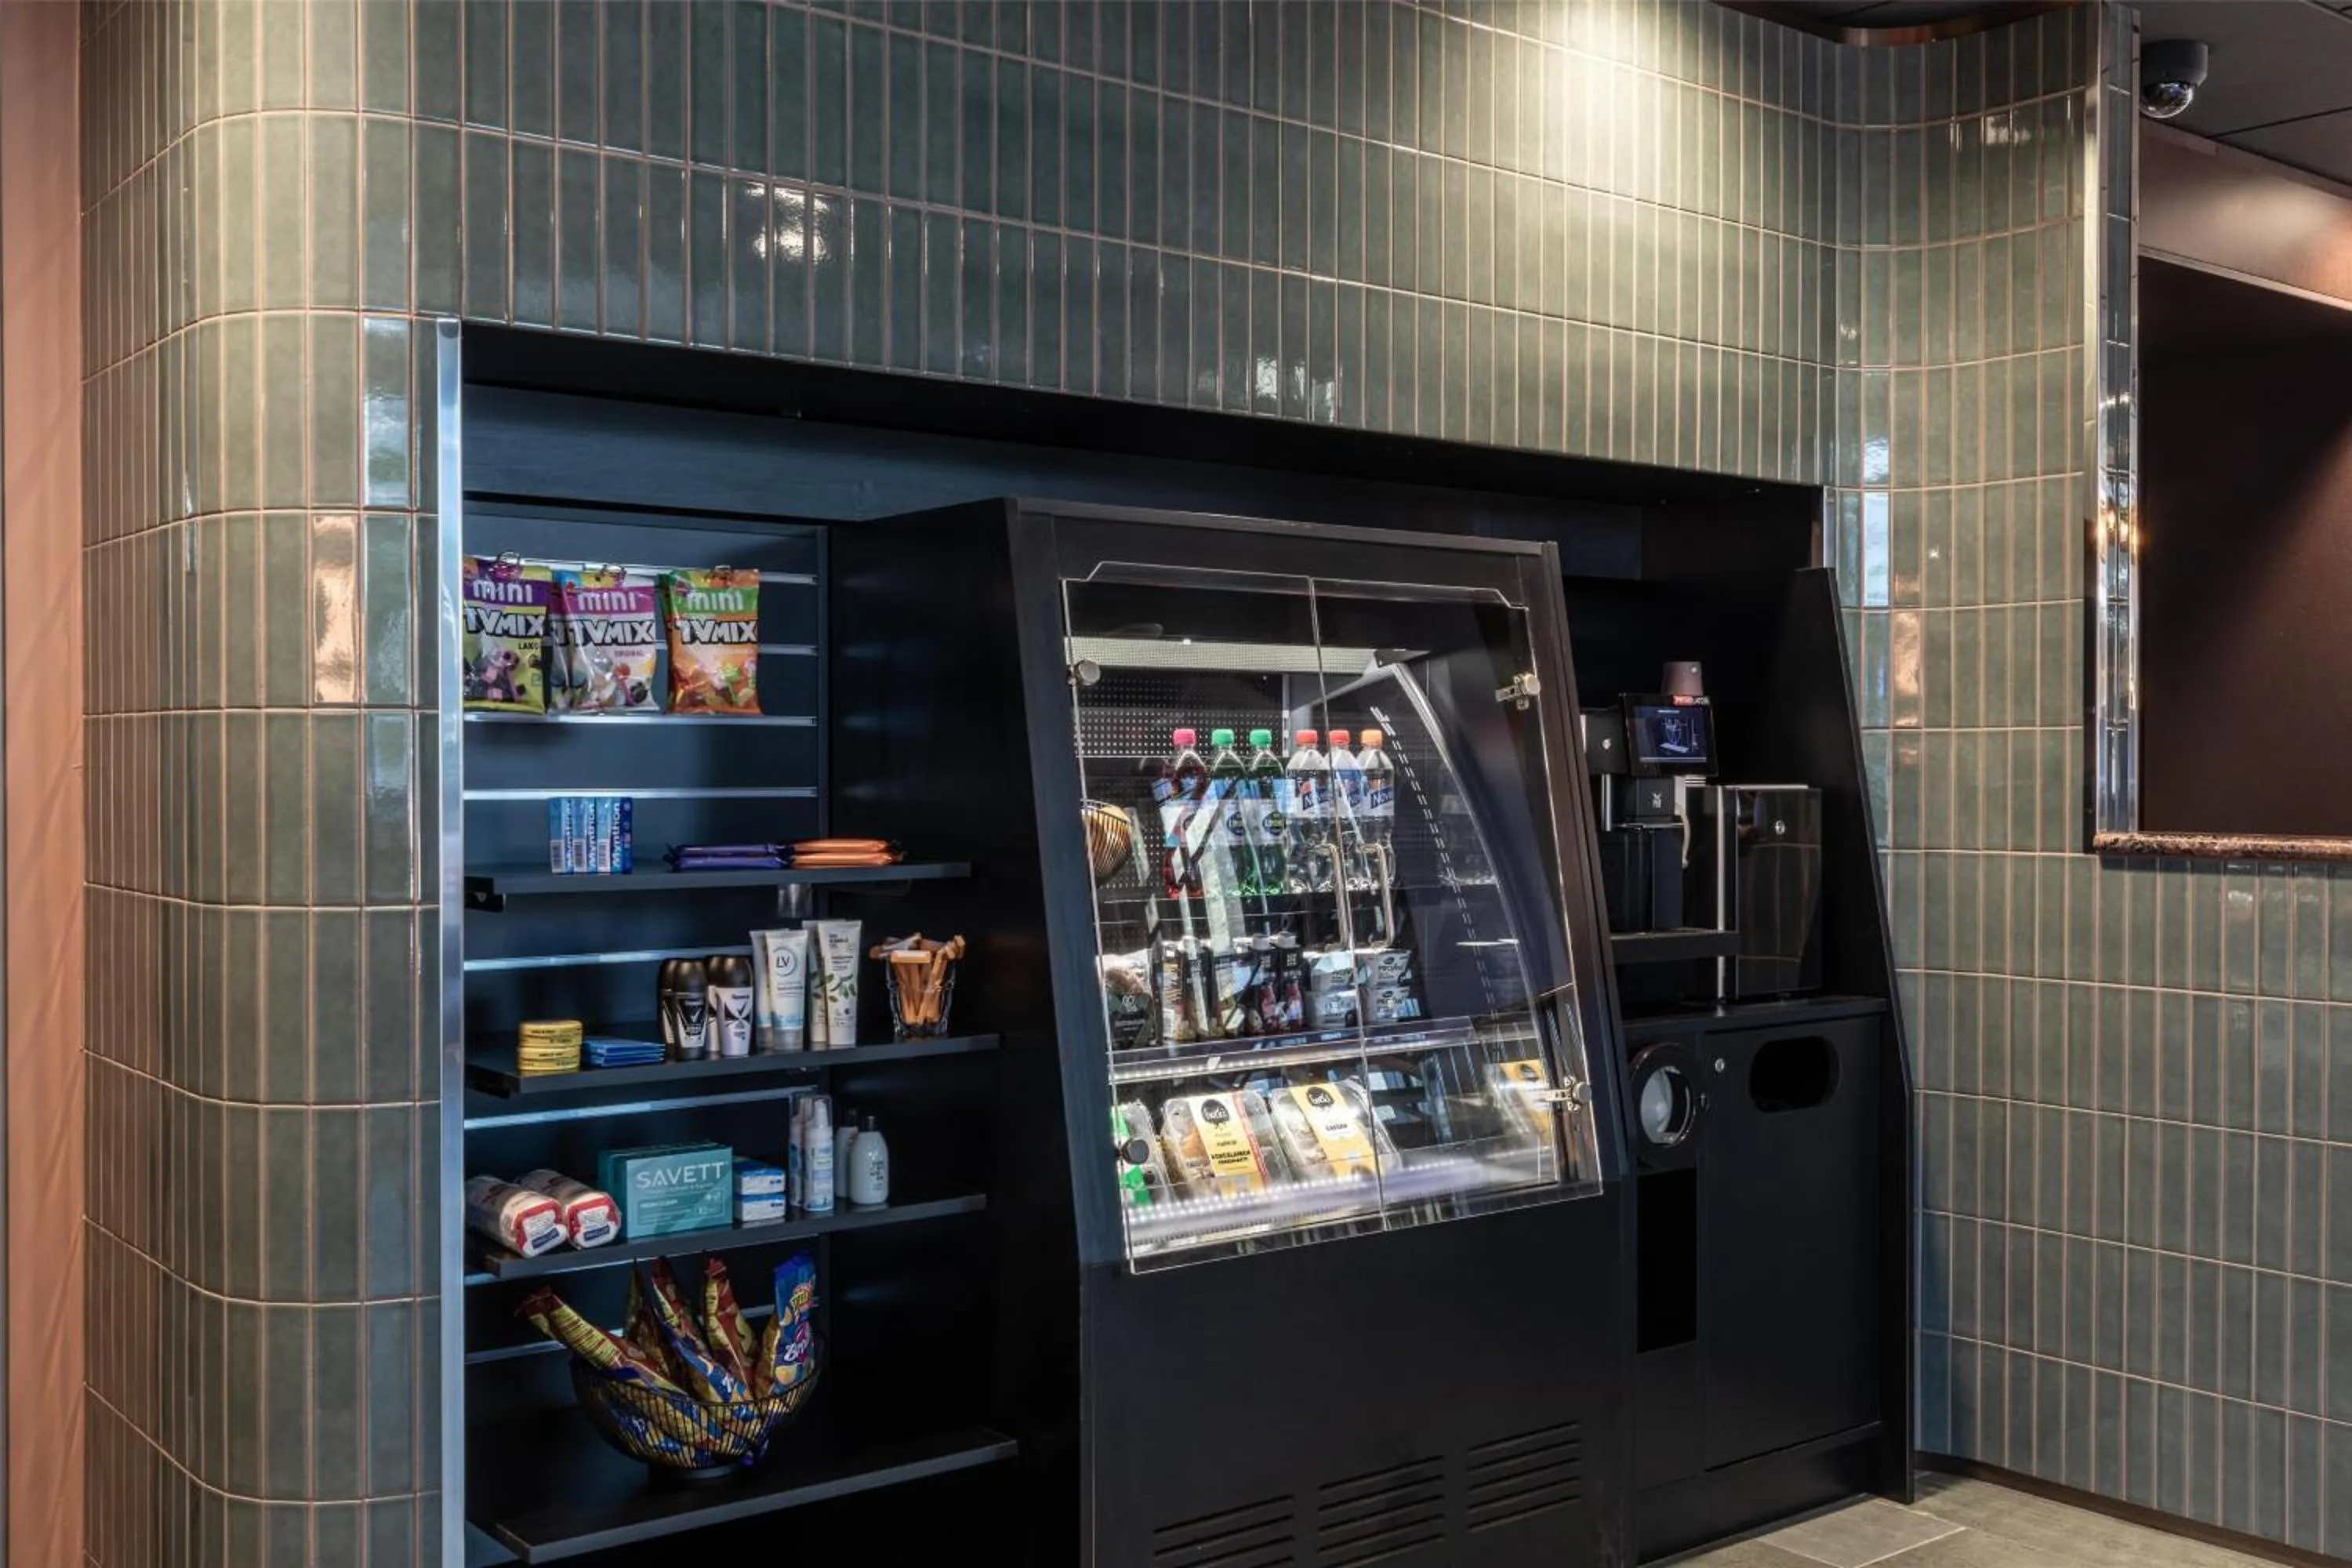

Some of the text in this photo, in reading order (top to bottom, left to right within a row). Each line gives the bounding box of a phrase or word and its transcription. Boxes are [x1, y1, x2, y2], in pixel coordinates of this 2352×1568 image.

[473, 579, 532, 603] mini
[577, 591, 637, 611] mini
[687, 590, 743, 611] mini
[612, 802, 621, 868] Mynthon
[776, 956, 790, 968] LV
[635, 1161, 724, 1189] SAVETT
